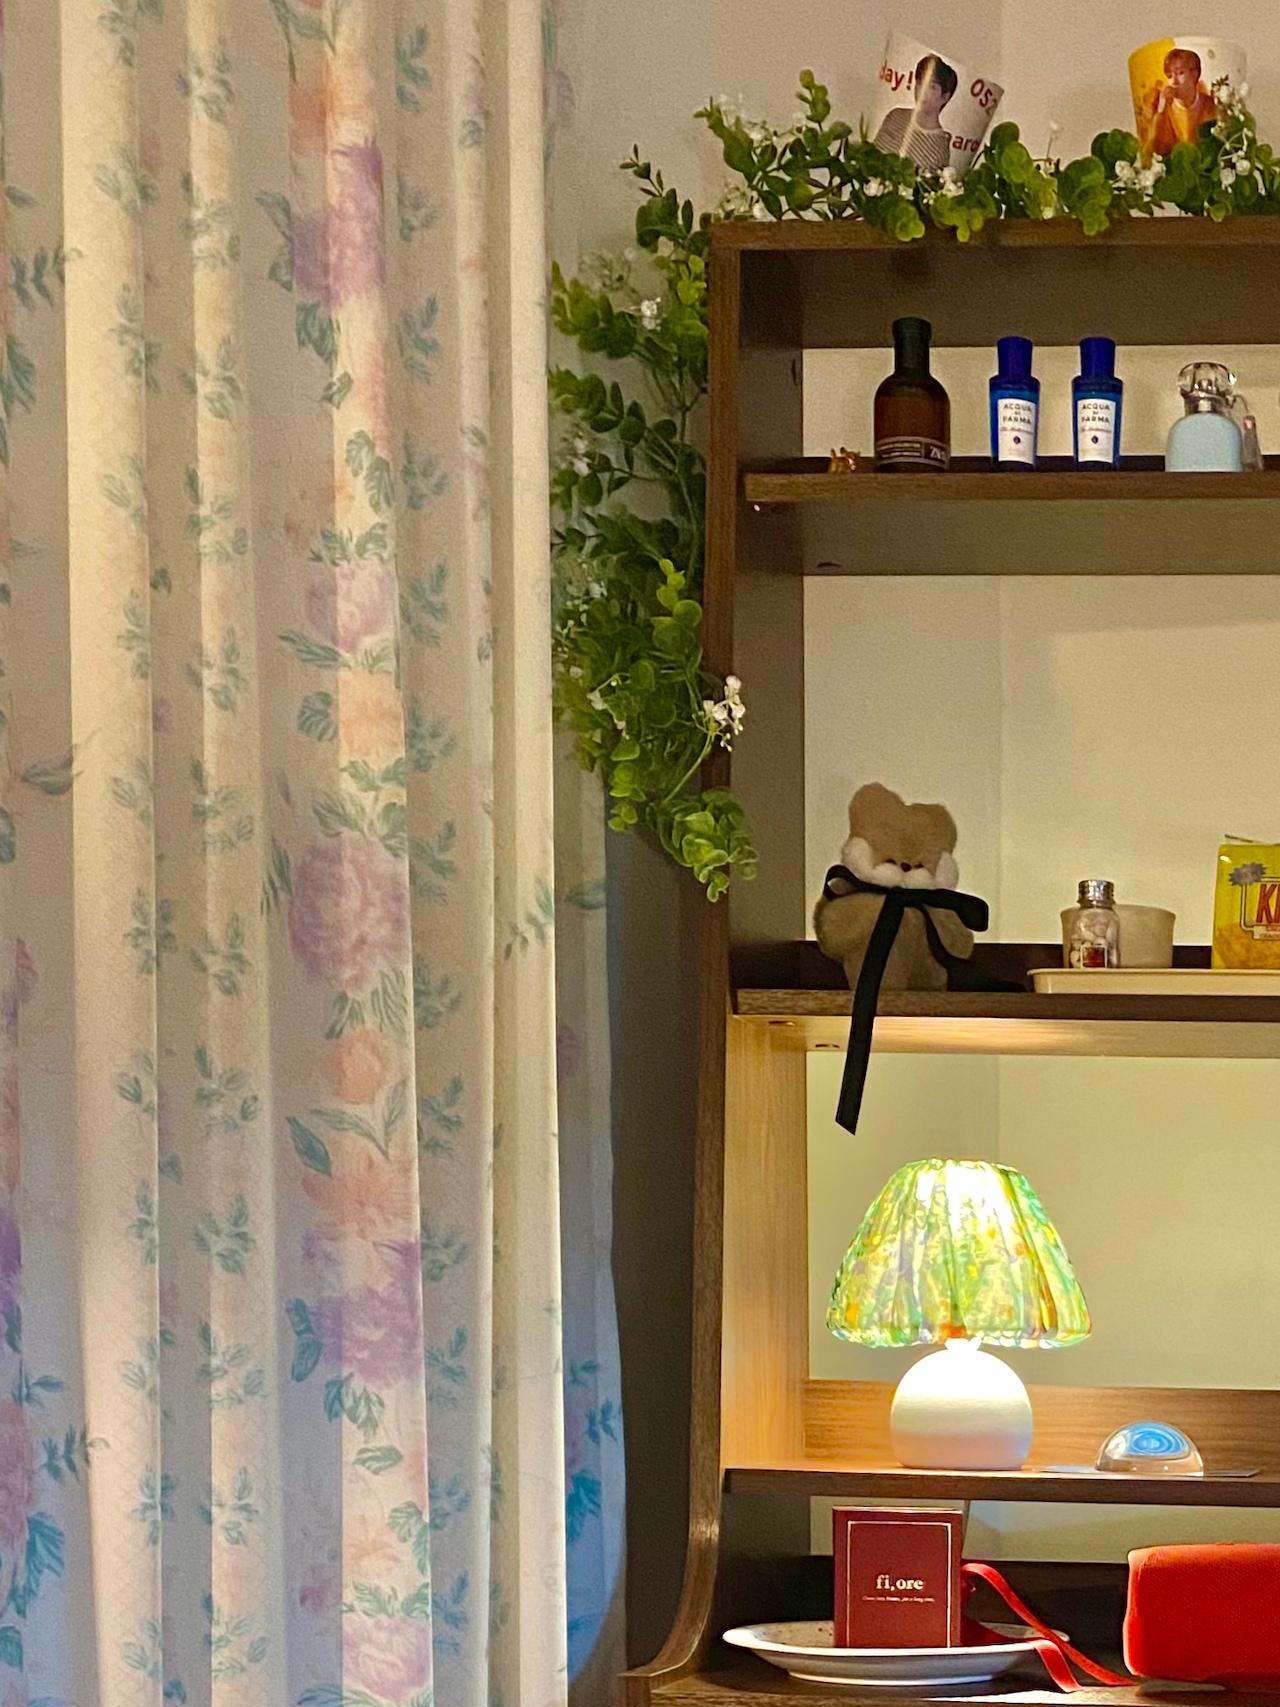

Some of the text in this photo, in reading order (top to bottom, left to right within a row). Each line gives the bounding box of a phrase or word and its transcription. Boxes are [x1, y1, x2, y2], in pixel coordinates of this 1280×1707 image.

[1003, 403, 1033, 412] ACQUA
[1082, 403, 1110, 411] ACQUA
[1002, 416, 1032, 425] PARMA
[1081, 416, 1110, 424] PARMA
[876, 1574, 924, 1591] fi,ore
